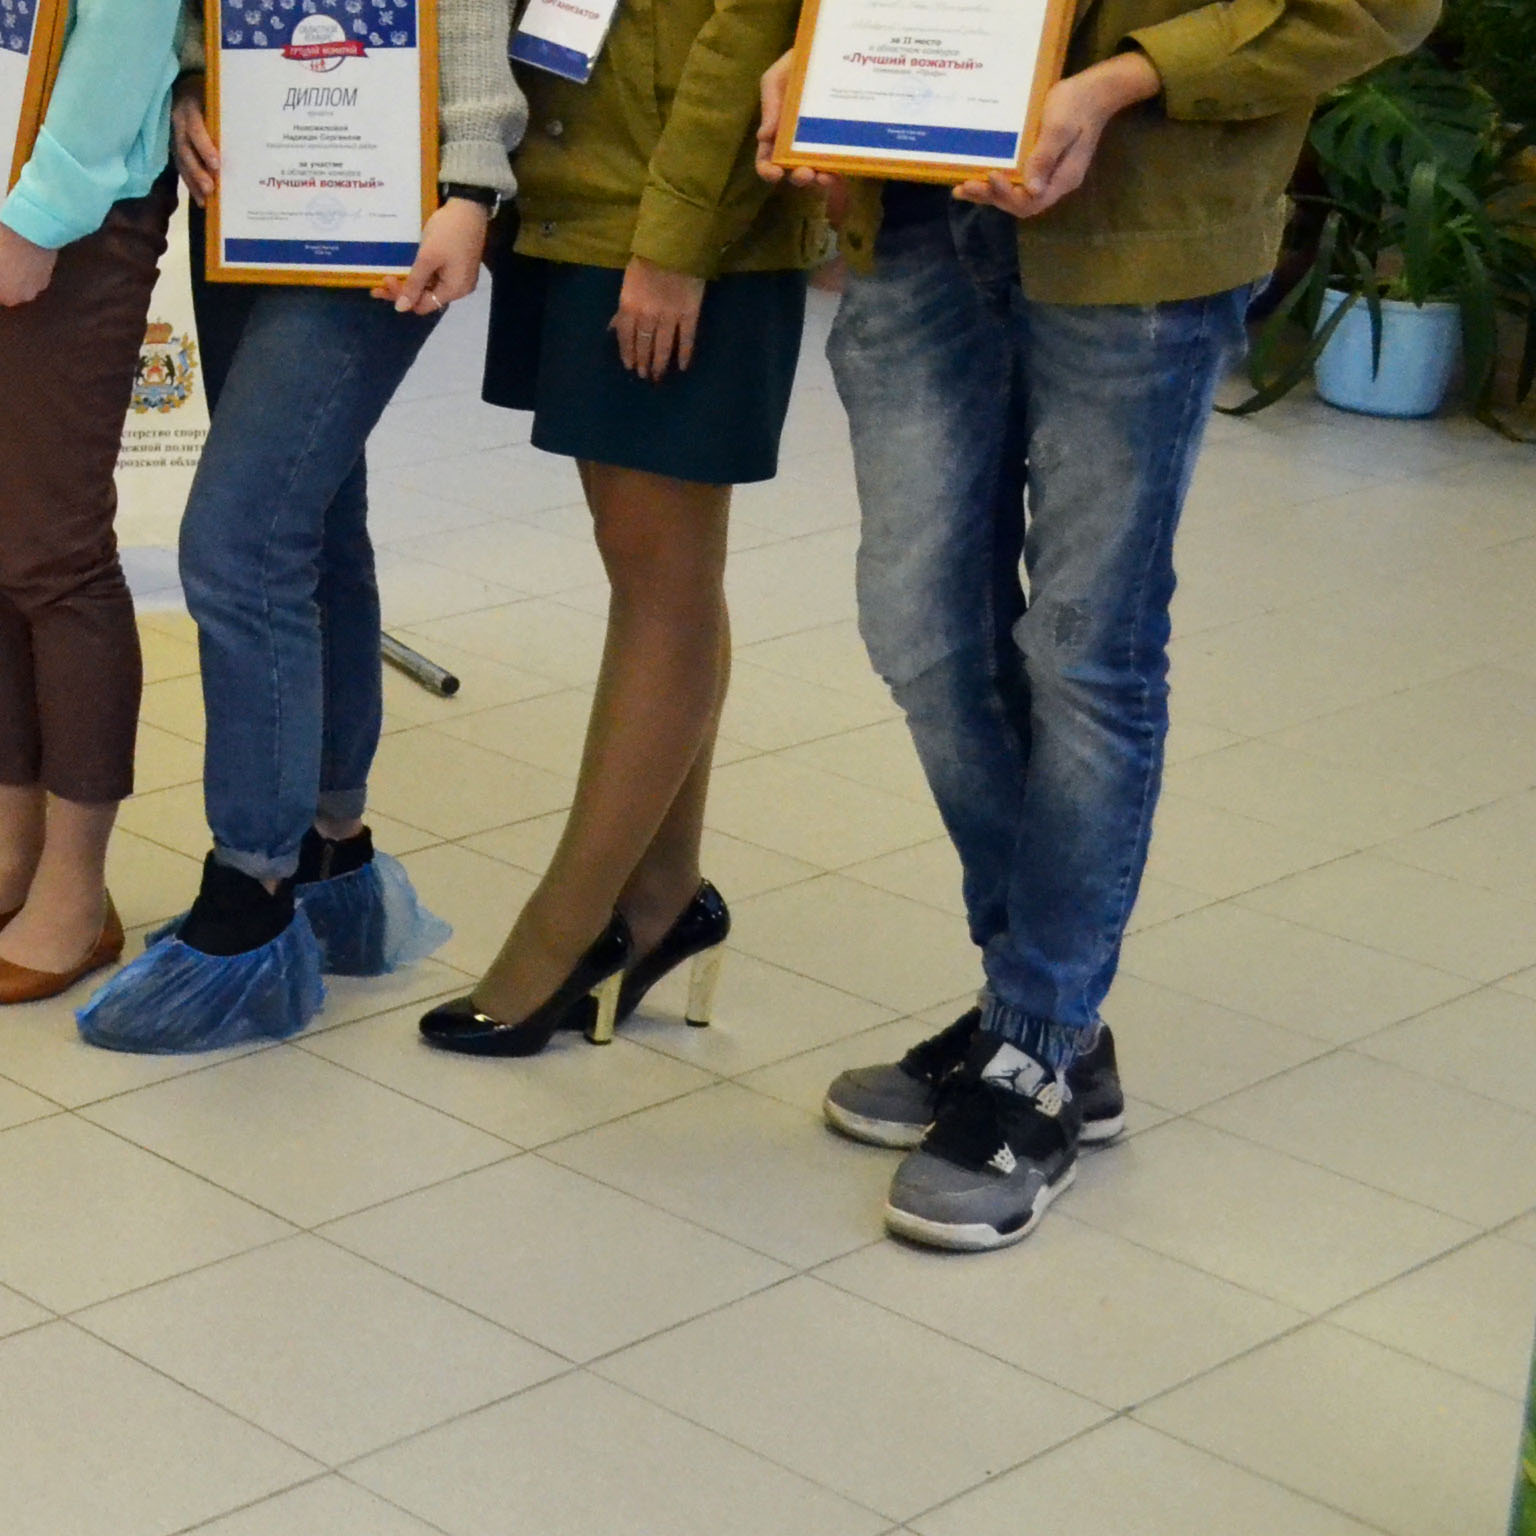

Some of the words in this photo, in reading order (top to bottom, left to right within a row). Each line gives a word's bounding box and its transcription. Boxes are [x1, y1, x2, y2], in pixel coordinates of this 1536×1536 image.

[842, 52, 907, 67] «Лучший
[910, 57, 984, 71] вожатый»
[283, 87, 358, 111] ДИПЛОМ
[259, 176, 317, 189] «Лучший
[320, 177, 385, 190] вожатый»
